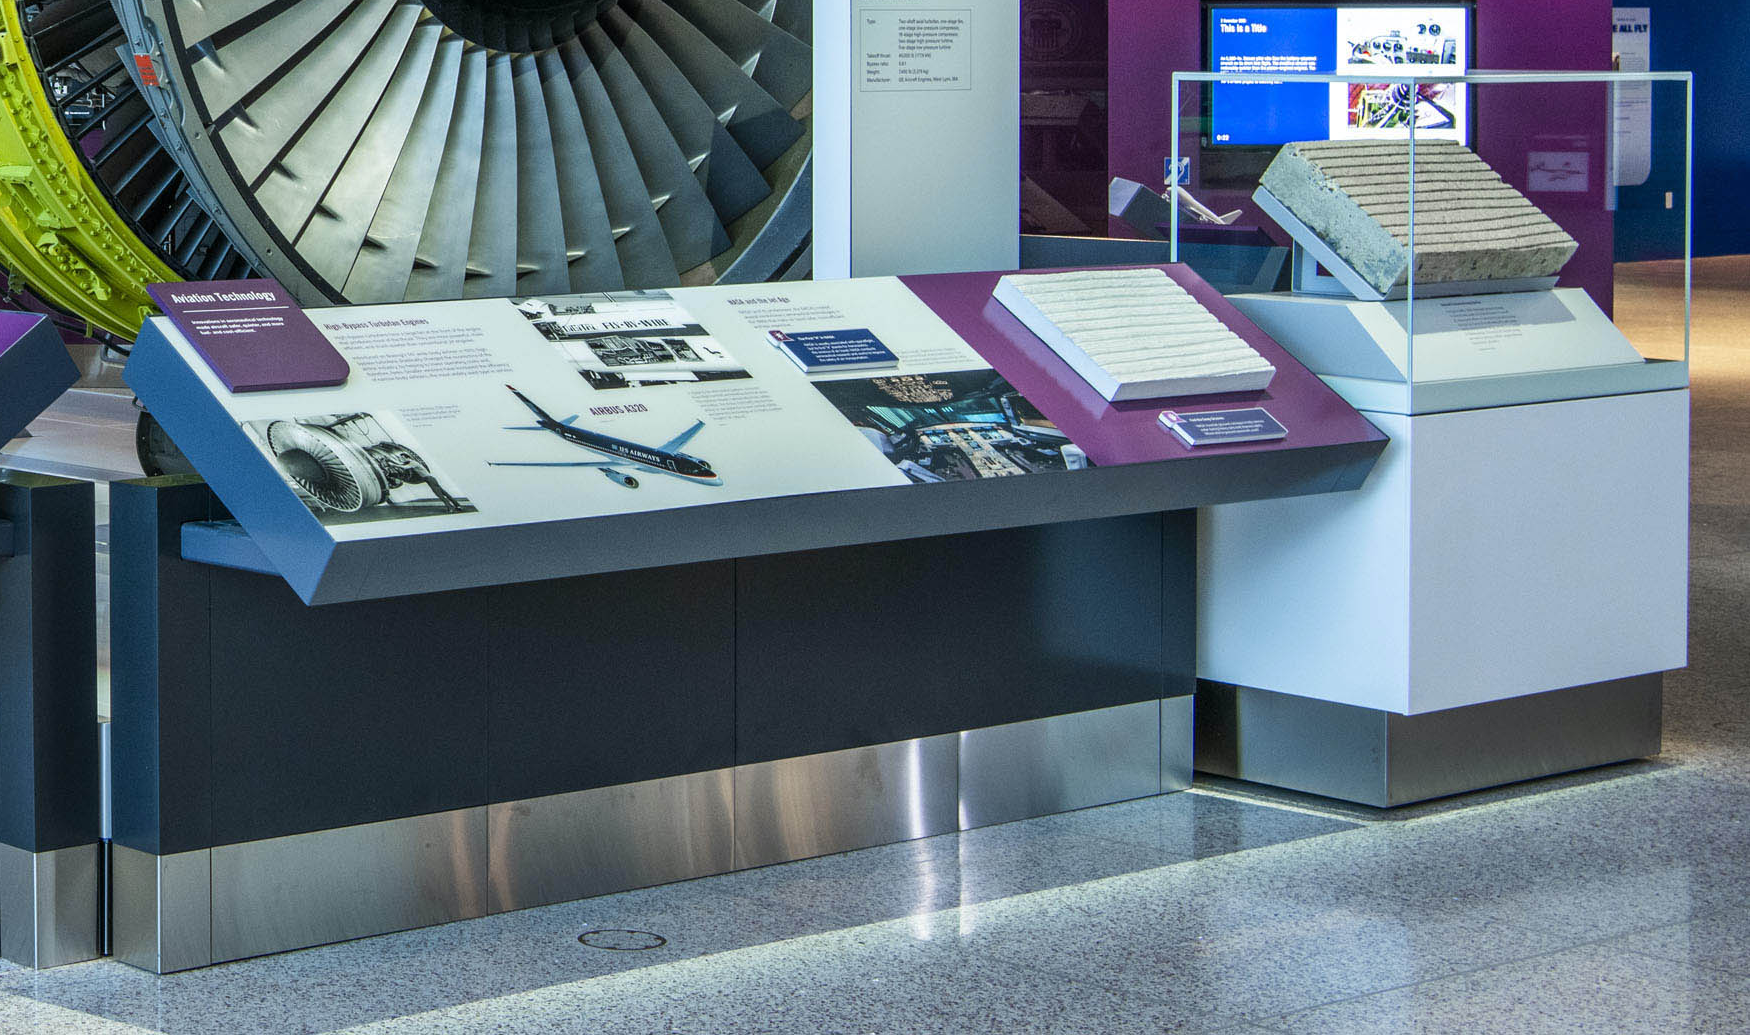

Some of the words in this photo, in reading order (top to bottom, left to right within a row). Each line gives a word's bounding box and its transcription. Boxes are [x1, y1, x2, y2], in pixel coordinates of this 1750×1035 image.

[1220, 24, 1233, 33] This
[1236, 24, 1243, 33] is
[1619, 24, 1633, 33] ALL
[1634, 24, 1648, 33] FLY
[170, 292, 215, 304] Aviation
[213, 290, 276, 303] Technology
[323, 319, 369, 332] High-Bypass
[369, 318, 400, 329] Turbofan
[400, 317, 429, 328] Engines
[589, 404, 623, 416] AIRBUS
[623, 403, 648, 414] A320
[629, 448, 661, 463] AIRWAYS
